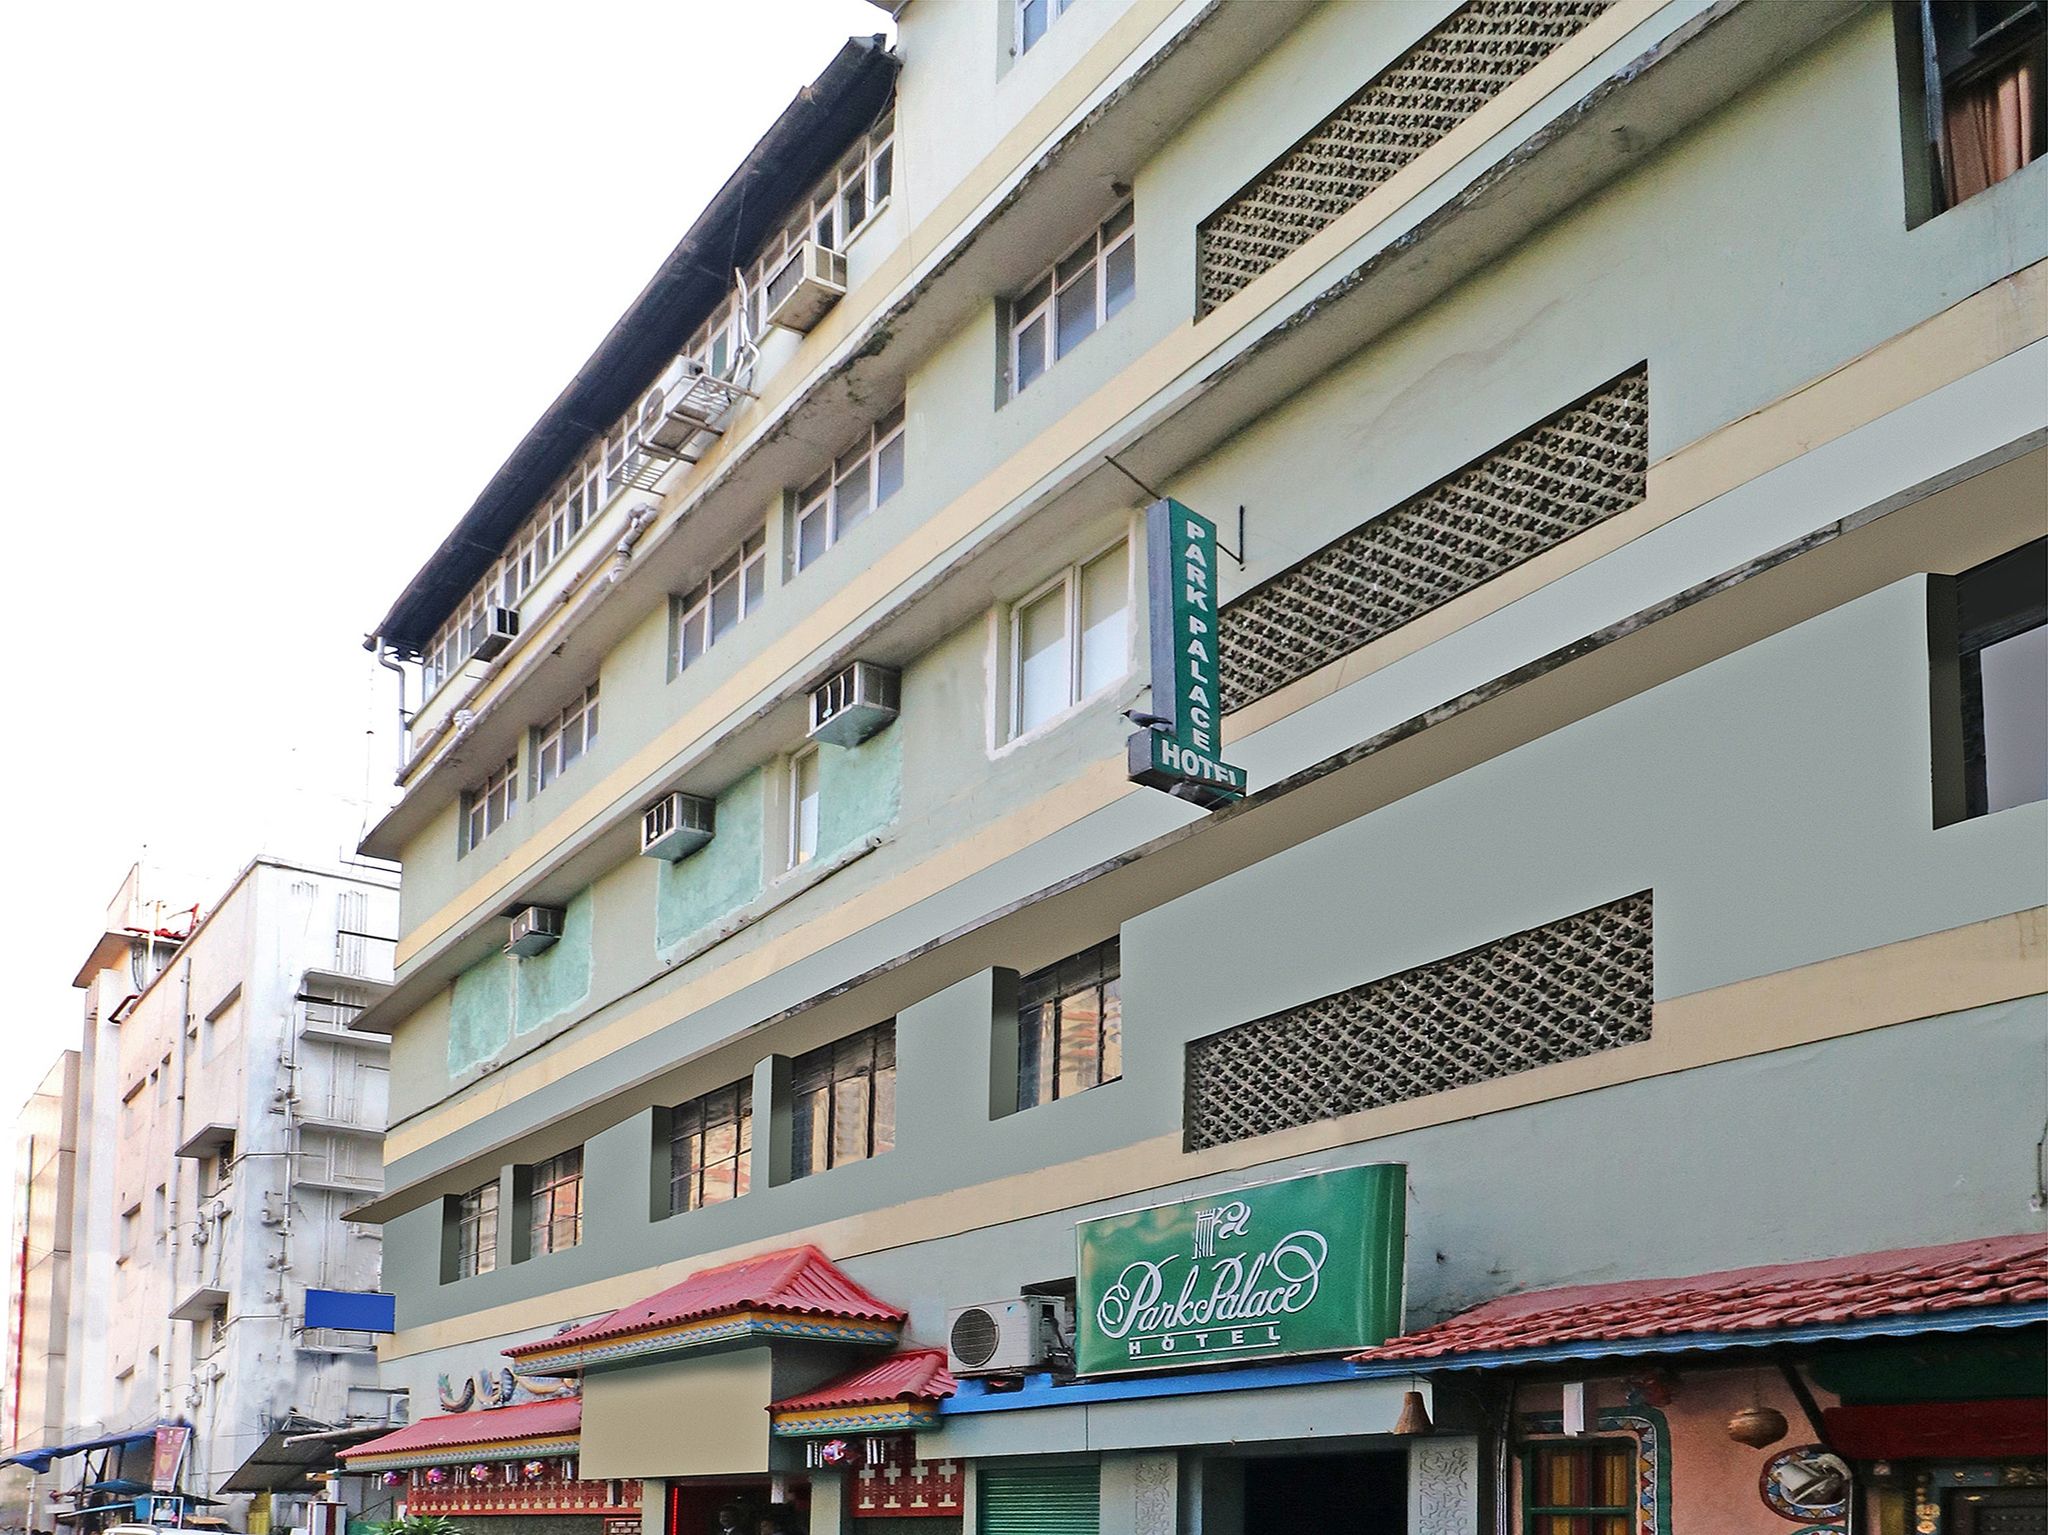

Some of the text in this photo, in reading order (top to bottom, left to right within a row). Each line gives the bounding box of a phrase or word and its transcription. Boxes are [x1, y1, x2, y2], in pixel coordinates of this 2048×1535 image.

[1186, 519, 1211, 752] PARK PALACE
[1097, 1230, 1328, 1338] Park Palace
[1129, 1326, 1281, 1355] HOTEL
